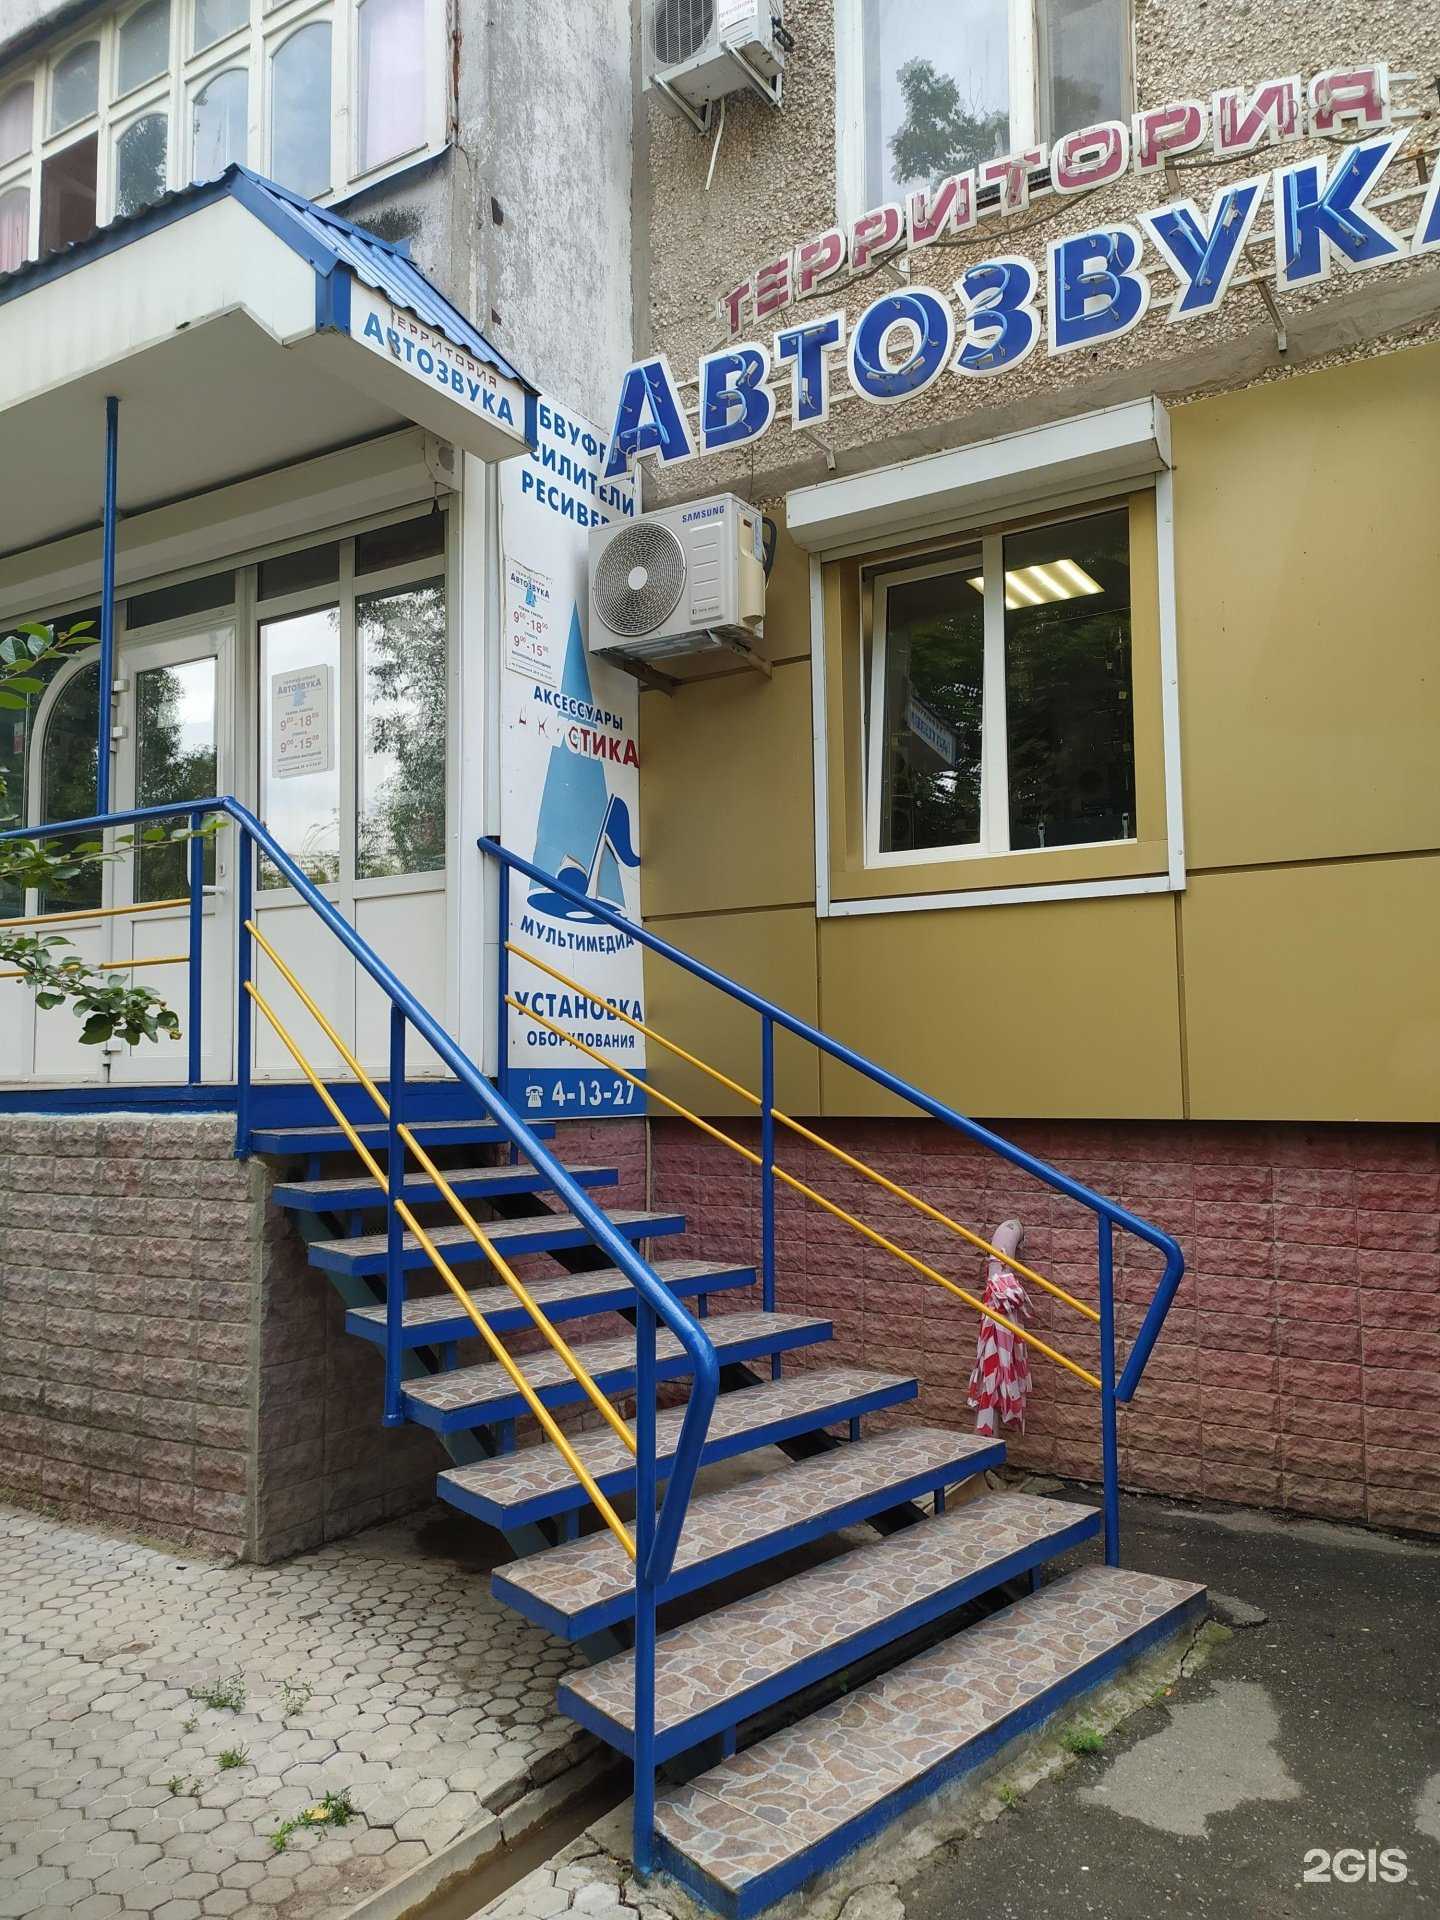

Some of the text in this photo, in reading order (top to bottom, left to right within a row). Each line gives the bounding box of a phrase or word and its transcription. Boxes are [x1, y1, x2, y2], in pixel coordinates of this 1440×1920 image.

[720, 62, 1389, 340] ТЕРРИТОРИЯ
[600, 130, 1440, 480] АВТОЗВУК
[393, 313, 498, 388] ЕРРИТОРИЯ
[682, 506, 725, 523] SAMSUNG
[534, 686, 623, 731] АКСЕССУАРЫ
[520, 915, 634, 955] МУЛЬТИМЕДИА
[515, 991, 643, 1022] УСТАНОВКА
[527, 1030, 635, 1050] ОБОРУДОВАНИЯ
[551, 1080, 635, 1107] 4-13-27
